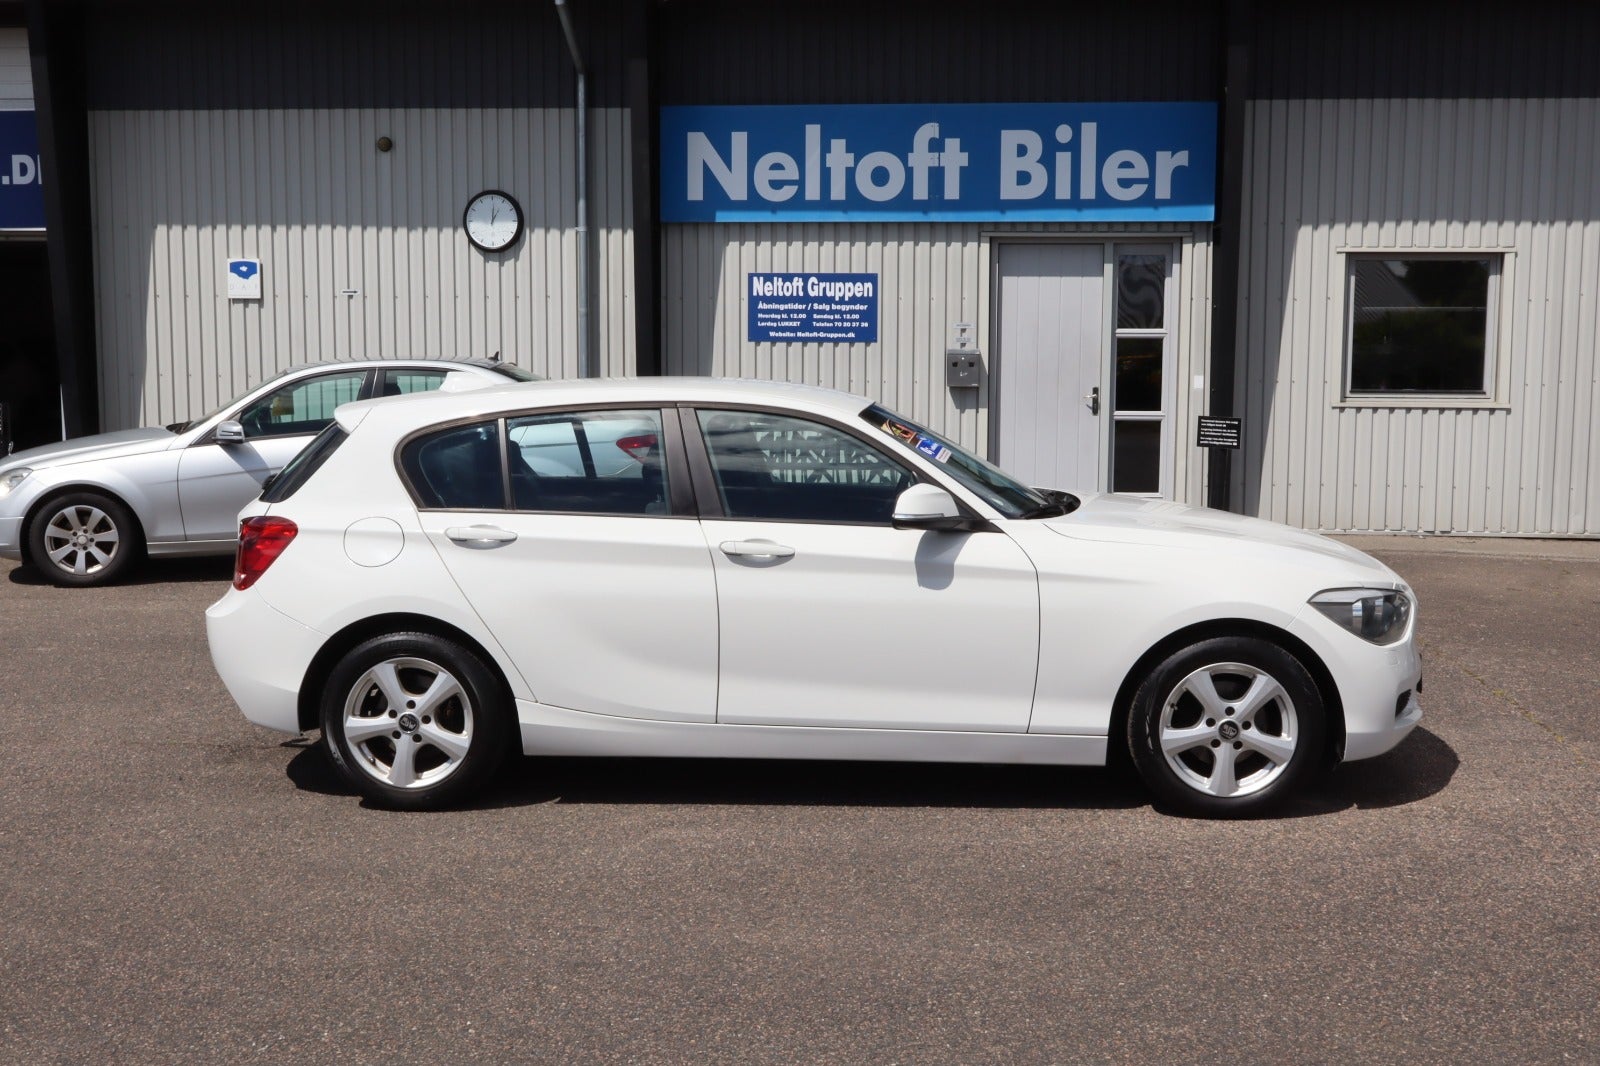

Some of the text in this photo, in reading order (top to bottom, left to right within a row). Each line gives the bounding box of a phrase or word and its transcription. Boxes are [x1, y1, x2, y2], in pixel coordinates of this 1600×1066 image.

[1, 154, 42, 185] .D
[686, 121, 1189, 202] Neltoft Biler
[752, 276, 873, 301] Neltoft Gruppen
[757, 301, 806, 311] Åbningstider
[812, 303, 831, 311] Salg
[831, 303, 868, 311] begynder
[796, 331, 856, 339] Neltoft-Gruppen.dk
